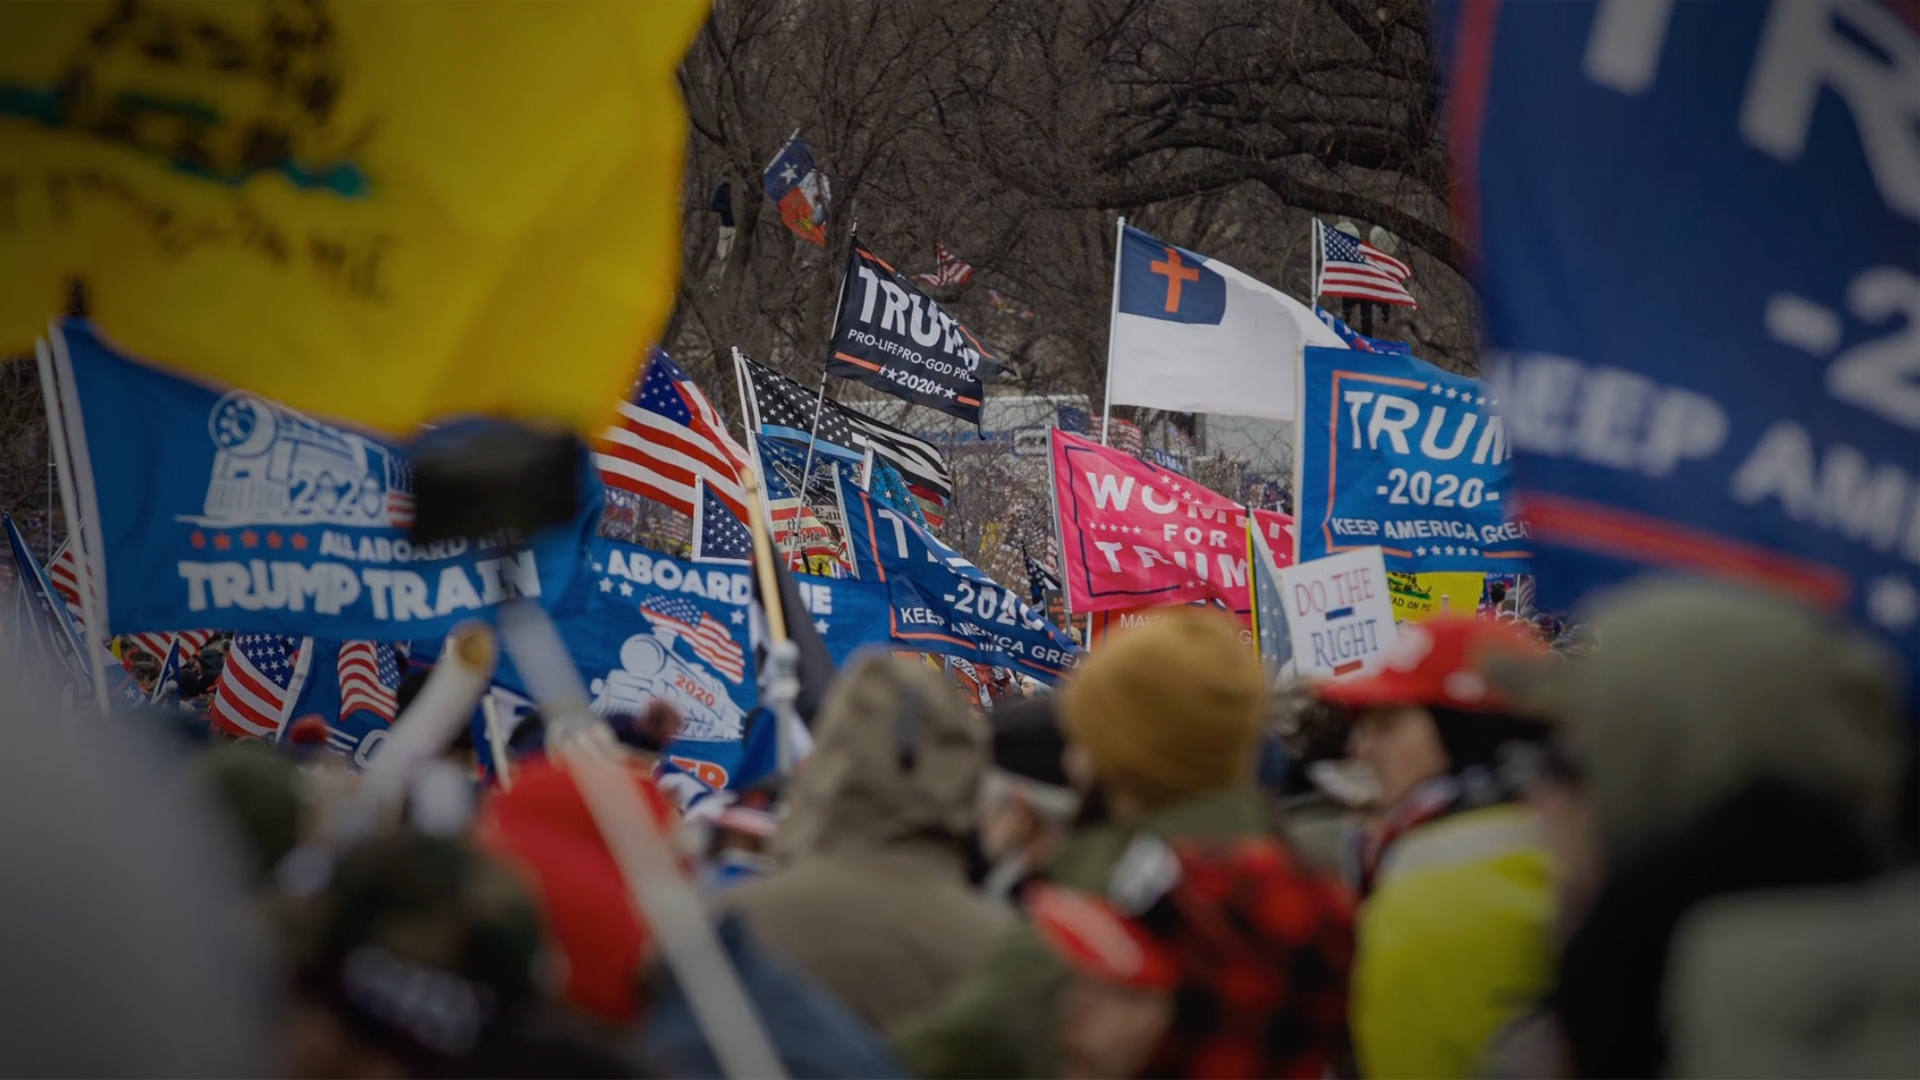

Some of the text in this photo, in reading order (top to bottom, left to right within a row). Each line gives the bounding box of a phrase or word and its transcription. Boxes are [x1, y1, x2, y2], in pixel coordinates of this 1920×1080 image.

[1344, 390, 1514, 466] TRUM
[288, 470, 383, 518] 2020
[1376, 468, 1500, 509] -2020-
[1164, 523, 1228, 549] FOR
[1331, 518, 1380, 537] KEEP
[1384, 517, 1480, 542] AMERICA
[178, 550, 541, 622] TRUMP TRAIN
[607, 549, 754, 606] ABOARD
[1094, 541, 1250, 589] TRUM
[1295, 567, 1377, 617] DO THE
[1311, 620, 1380, 668] RIGHT
[675, 674, 715, 708] 2020
